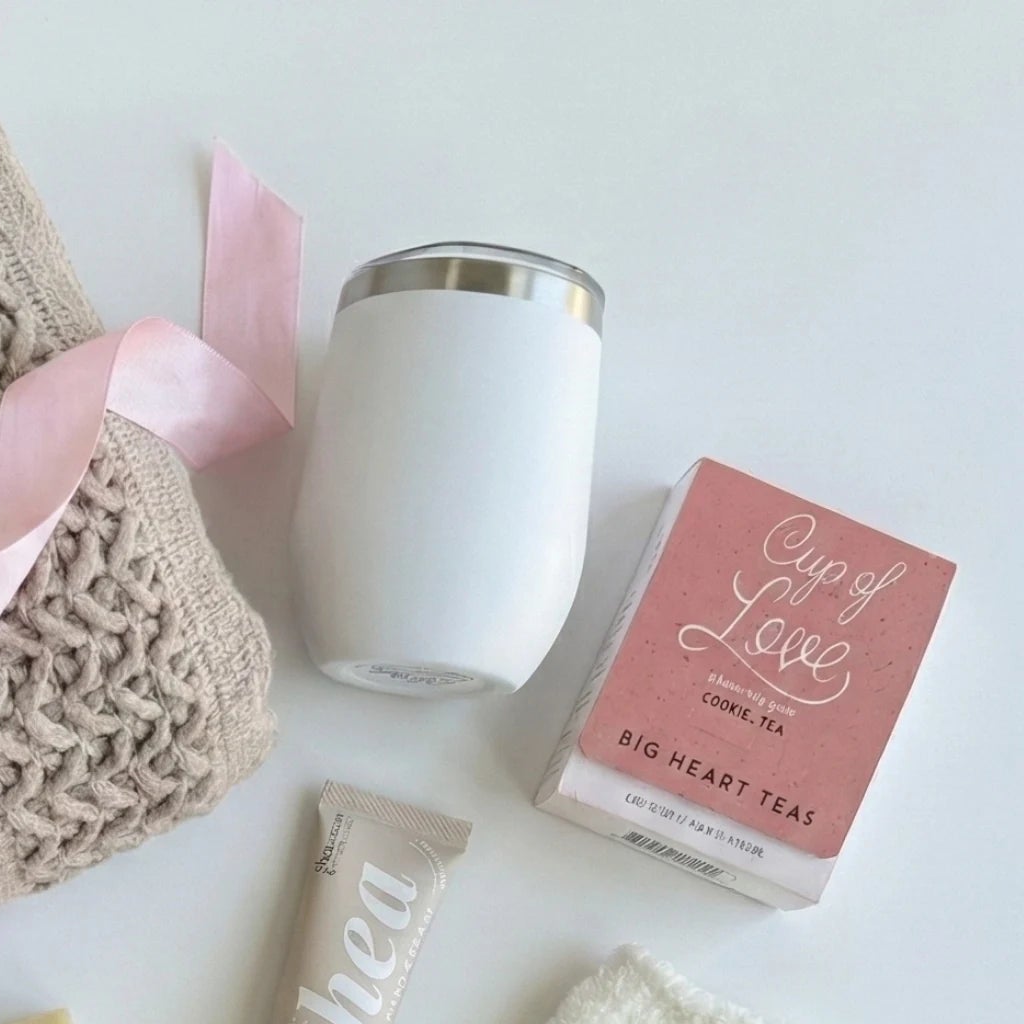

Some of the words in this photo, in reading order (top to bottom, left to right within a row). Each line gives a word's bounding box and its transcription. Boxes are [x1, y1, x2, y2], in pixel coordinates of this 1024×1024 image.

[763, 514, 848, 606] Cup
[838, 562, 908, 625] of
[678, 570, 851, 705] Love
[618, 729, 661, 760] BIG
[668, 751, 750, 798] HEART
[759, 790, 817, 827] TEAS
[759, 716, 784, 737] TEA
